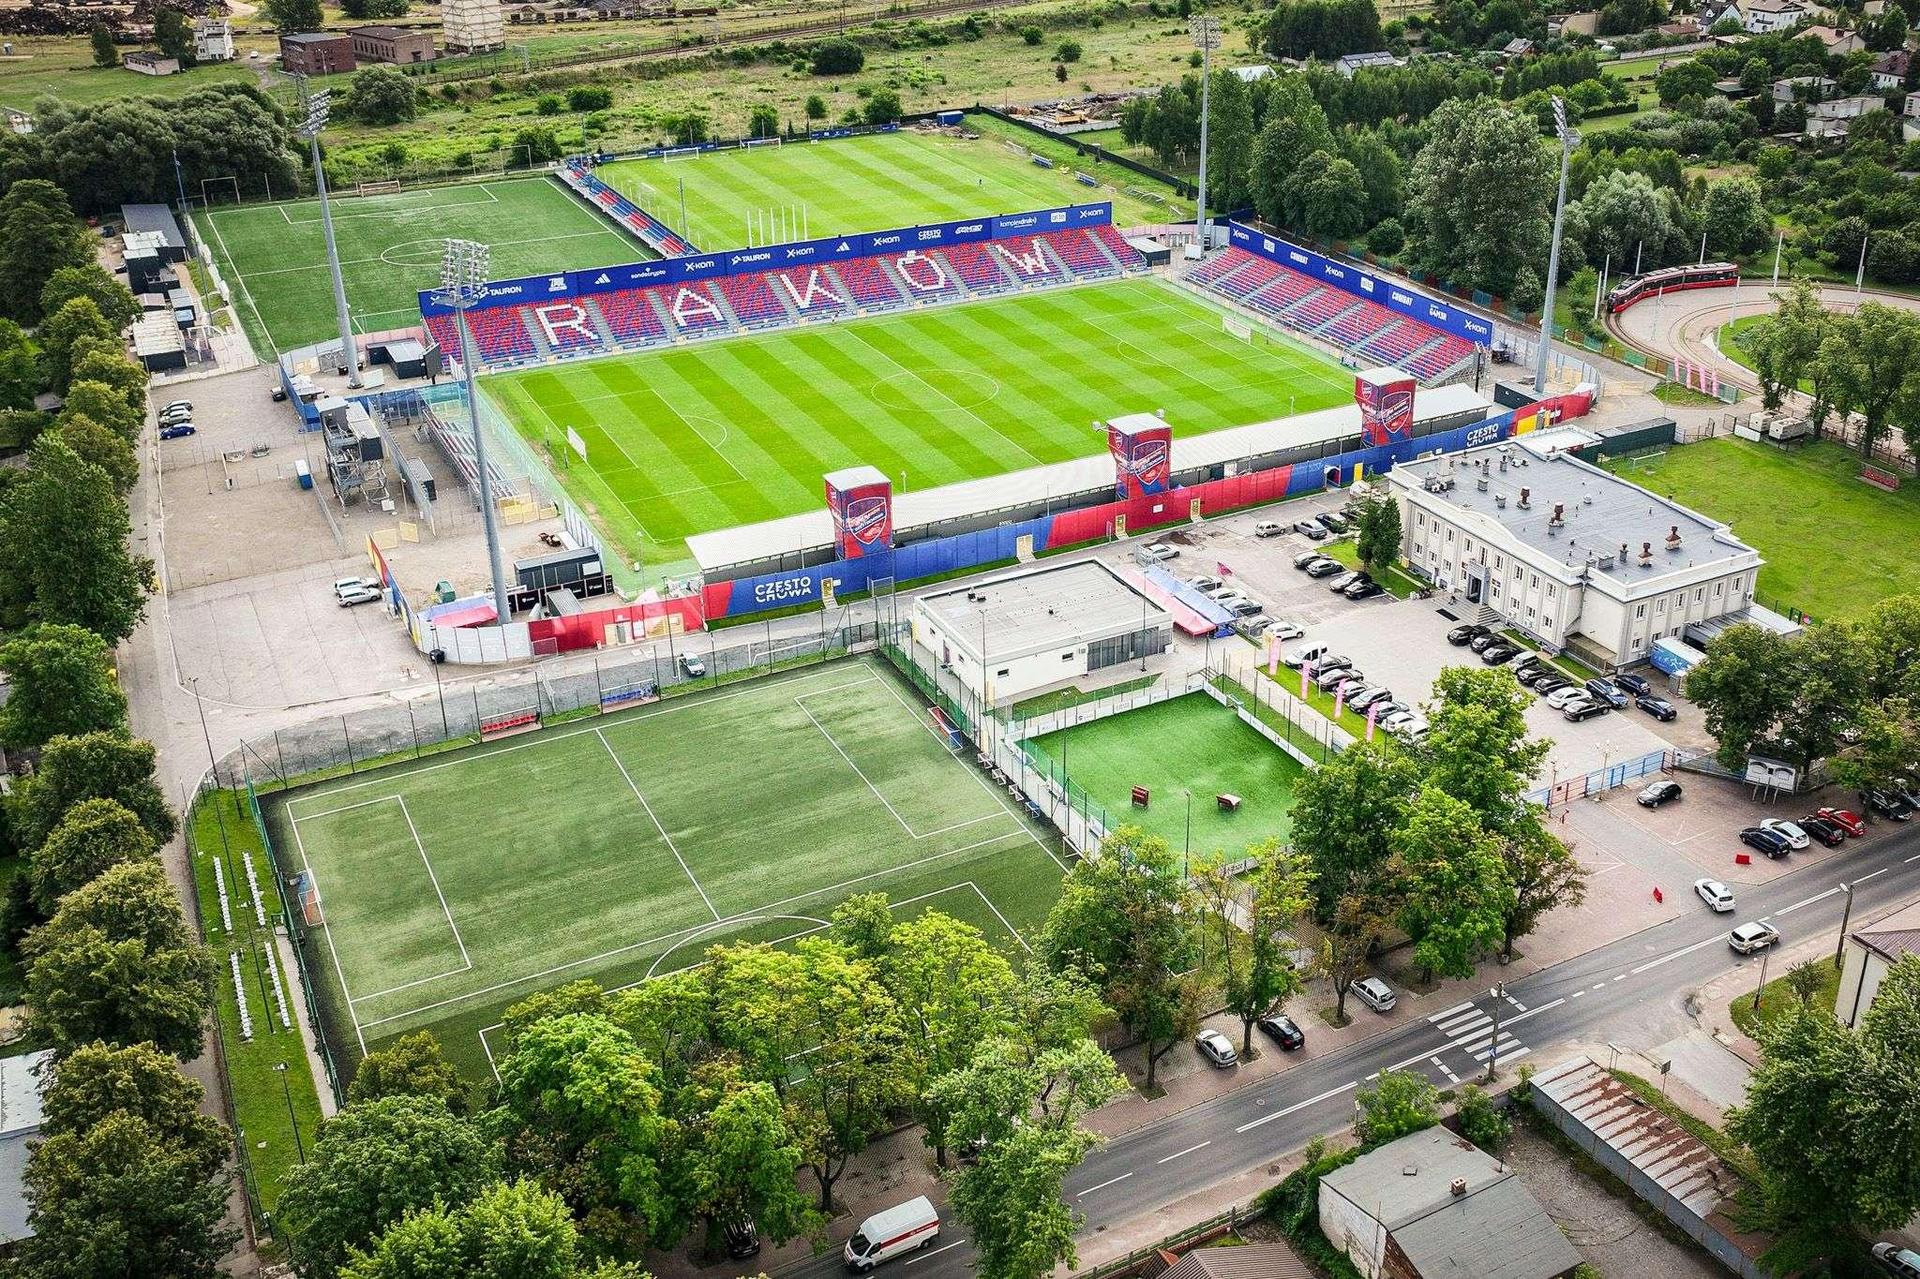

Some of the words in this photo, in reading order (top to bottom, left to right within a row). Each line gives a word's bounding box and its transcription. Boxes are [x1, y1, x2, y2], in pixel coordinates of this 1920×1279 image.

[742, 253, 771, 263] TAURON
[489, 286, 522, 296] TAURON
[535, 238, 1051, 346] RAKÓW
